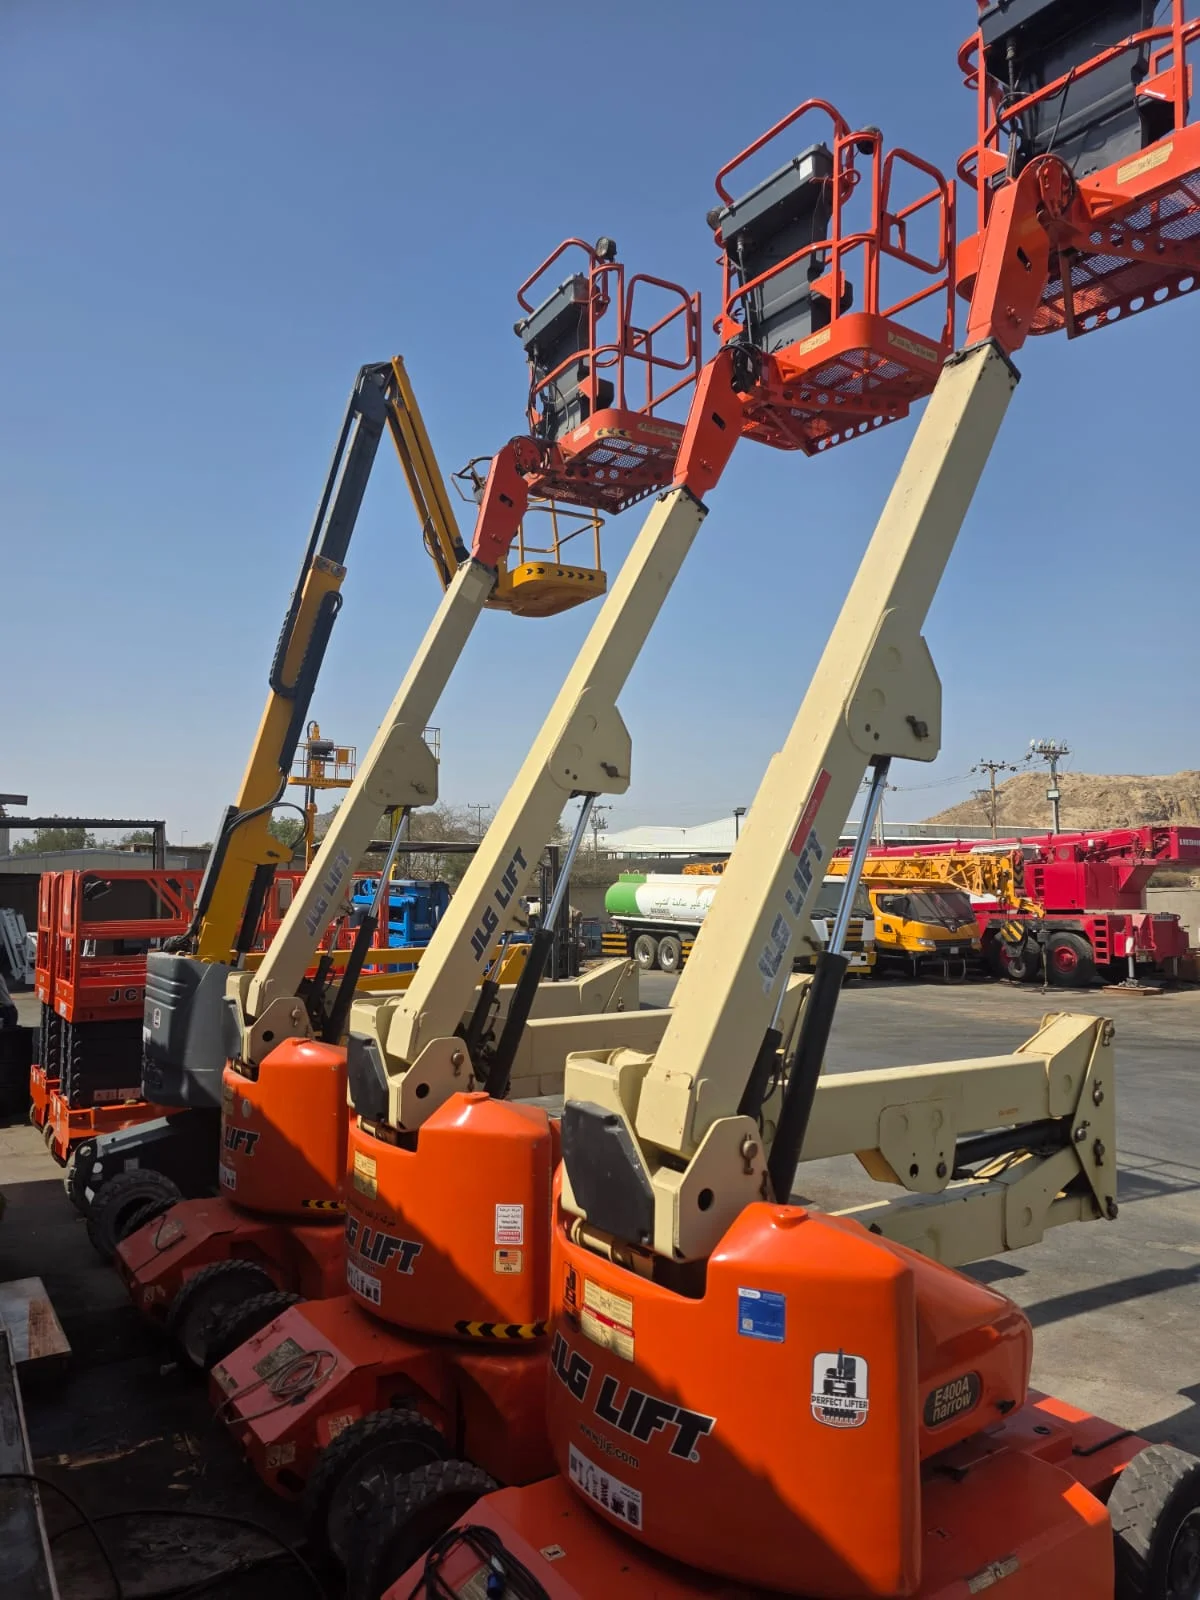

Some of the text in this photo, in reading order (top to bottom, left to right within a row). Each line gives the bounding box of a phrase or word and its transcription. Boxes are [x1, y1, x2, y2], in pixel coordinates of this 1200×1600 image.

[304, 847, 351, 937] JLG LIFT
[470, 846, 528, 963] JLG LIFT
[757, 911, 792, 995] JLG
[785, 826, 825, 920] LIFT
[360, 1226, 424, 1275] LIFT
[551, 1329, 718, 1461] JLG LIFT
[811, 1395, 868, 1409] PERFECT LIFTER
[932, 1391, 972, 1422] narrow
[934, 1376, 970, 1408] E400A
